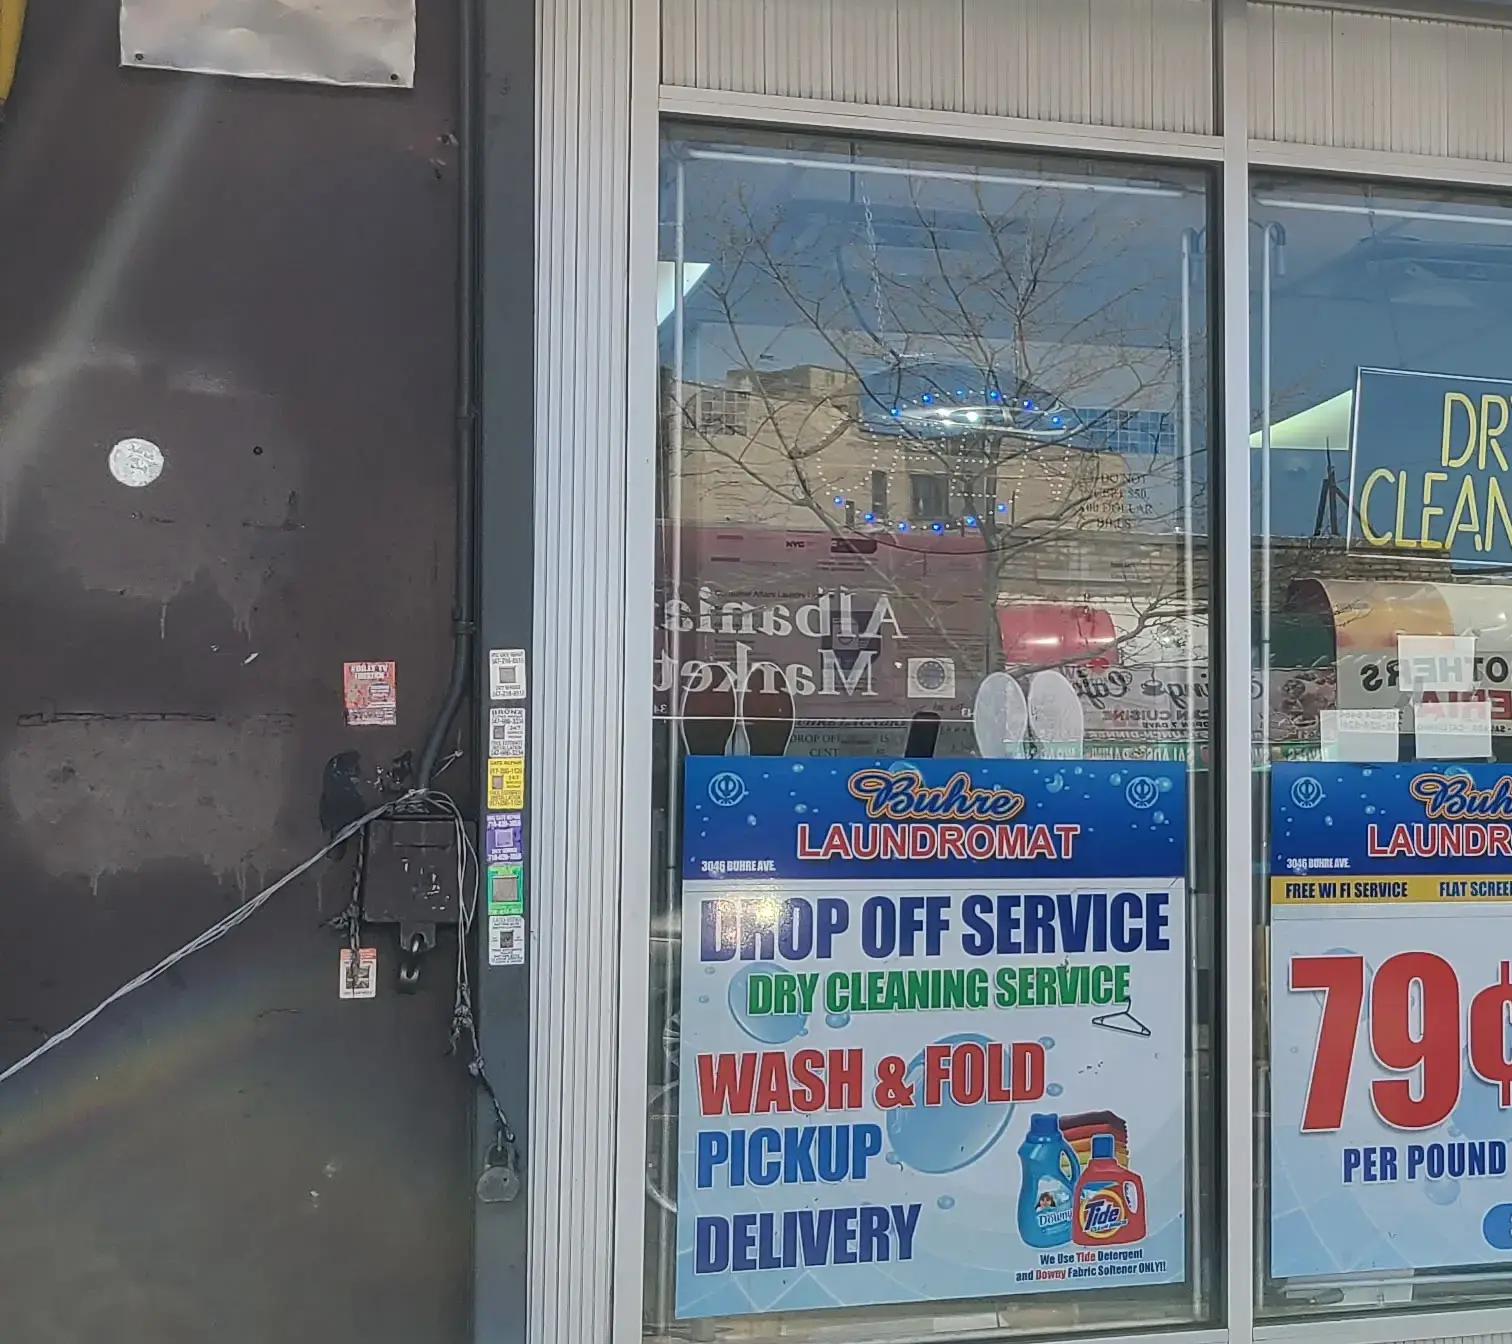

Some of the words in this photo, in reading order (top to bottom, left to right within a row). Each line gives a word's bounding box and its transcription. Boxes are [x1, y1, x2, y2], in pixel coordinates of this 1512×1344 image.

[849, 767, 1026, 820] Buhre
[795, 823, 1082, 860] LAUNDROMAT
[701, 860, 725, 872] 3046
[726, 860, 757, 872] BUHRE
[1308, 857, 1334, 869] BUHRE
[1285, 882, 1318, 899] FREE
[1318, 882, 1338, 898] WI
[1339, 882, 1352, 898] FI
[1353, 881, 1409, 898] SERVICE
[1439, 881, 1468, 897] FLAT
[861, 895, 951, 960] OFF
[960, 891, 1171, 956] SERVICE
[747, 972, 821, 1016] DRY
[825, 966, 990, 1013] CLEANING
[994, 964, 1132, 1008] SERVICE
[696, 1048, 864, 1117] WASH
[874, 1055, 917, 1110] &
[924, 1040, 1047, 1106] FOLD
[696, 1122, 884, 1190] PICKUP
[1342, 1145, 1398, 1184] PER
[1406, 1140, 1508, 1182] POUND
[1084, 1200, 1120, 1232] Tide
[693, 1202, 922, 1275] DELIVERY
[1040, 1254, 1056, 1265] We
[1057, 1253, 1075, 1264] Use
[1076, 1252, 1096, 1262] Tide
[1097, 1249, 1144, 1263] Detergent
[1015, 1270, 1034, 1282] and
[1035, 1269, 1066, 1283] Downy
[1067, 1266, 1097, 1279] Fabric
[1098, 1263, 1137, 1277] Softener
